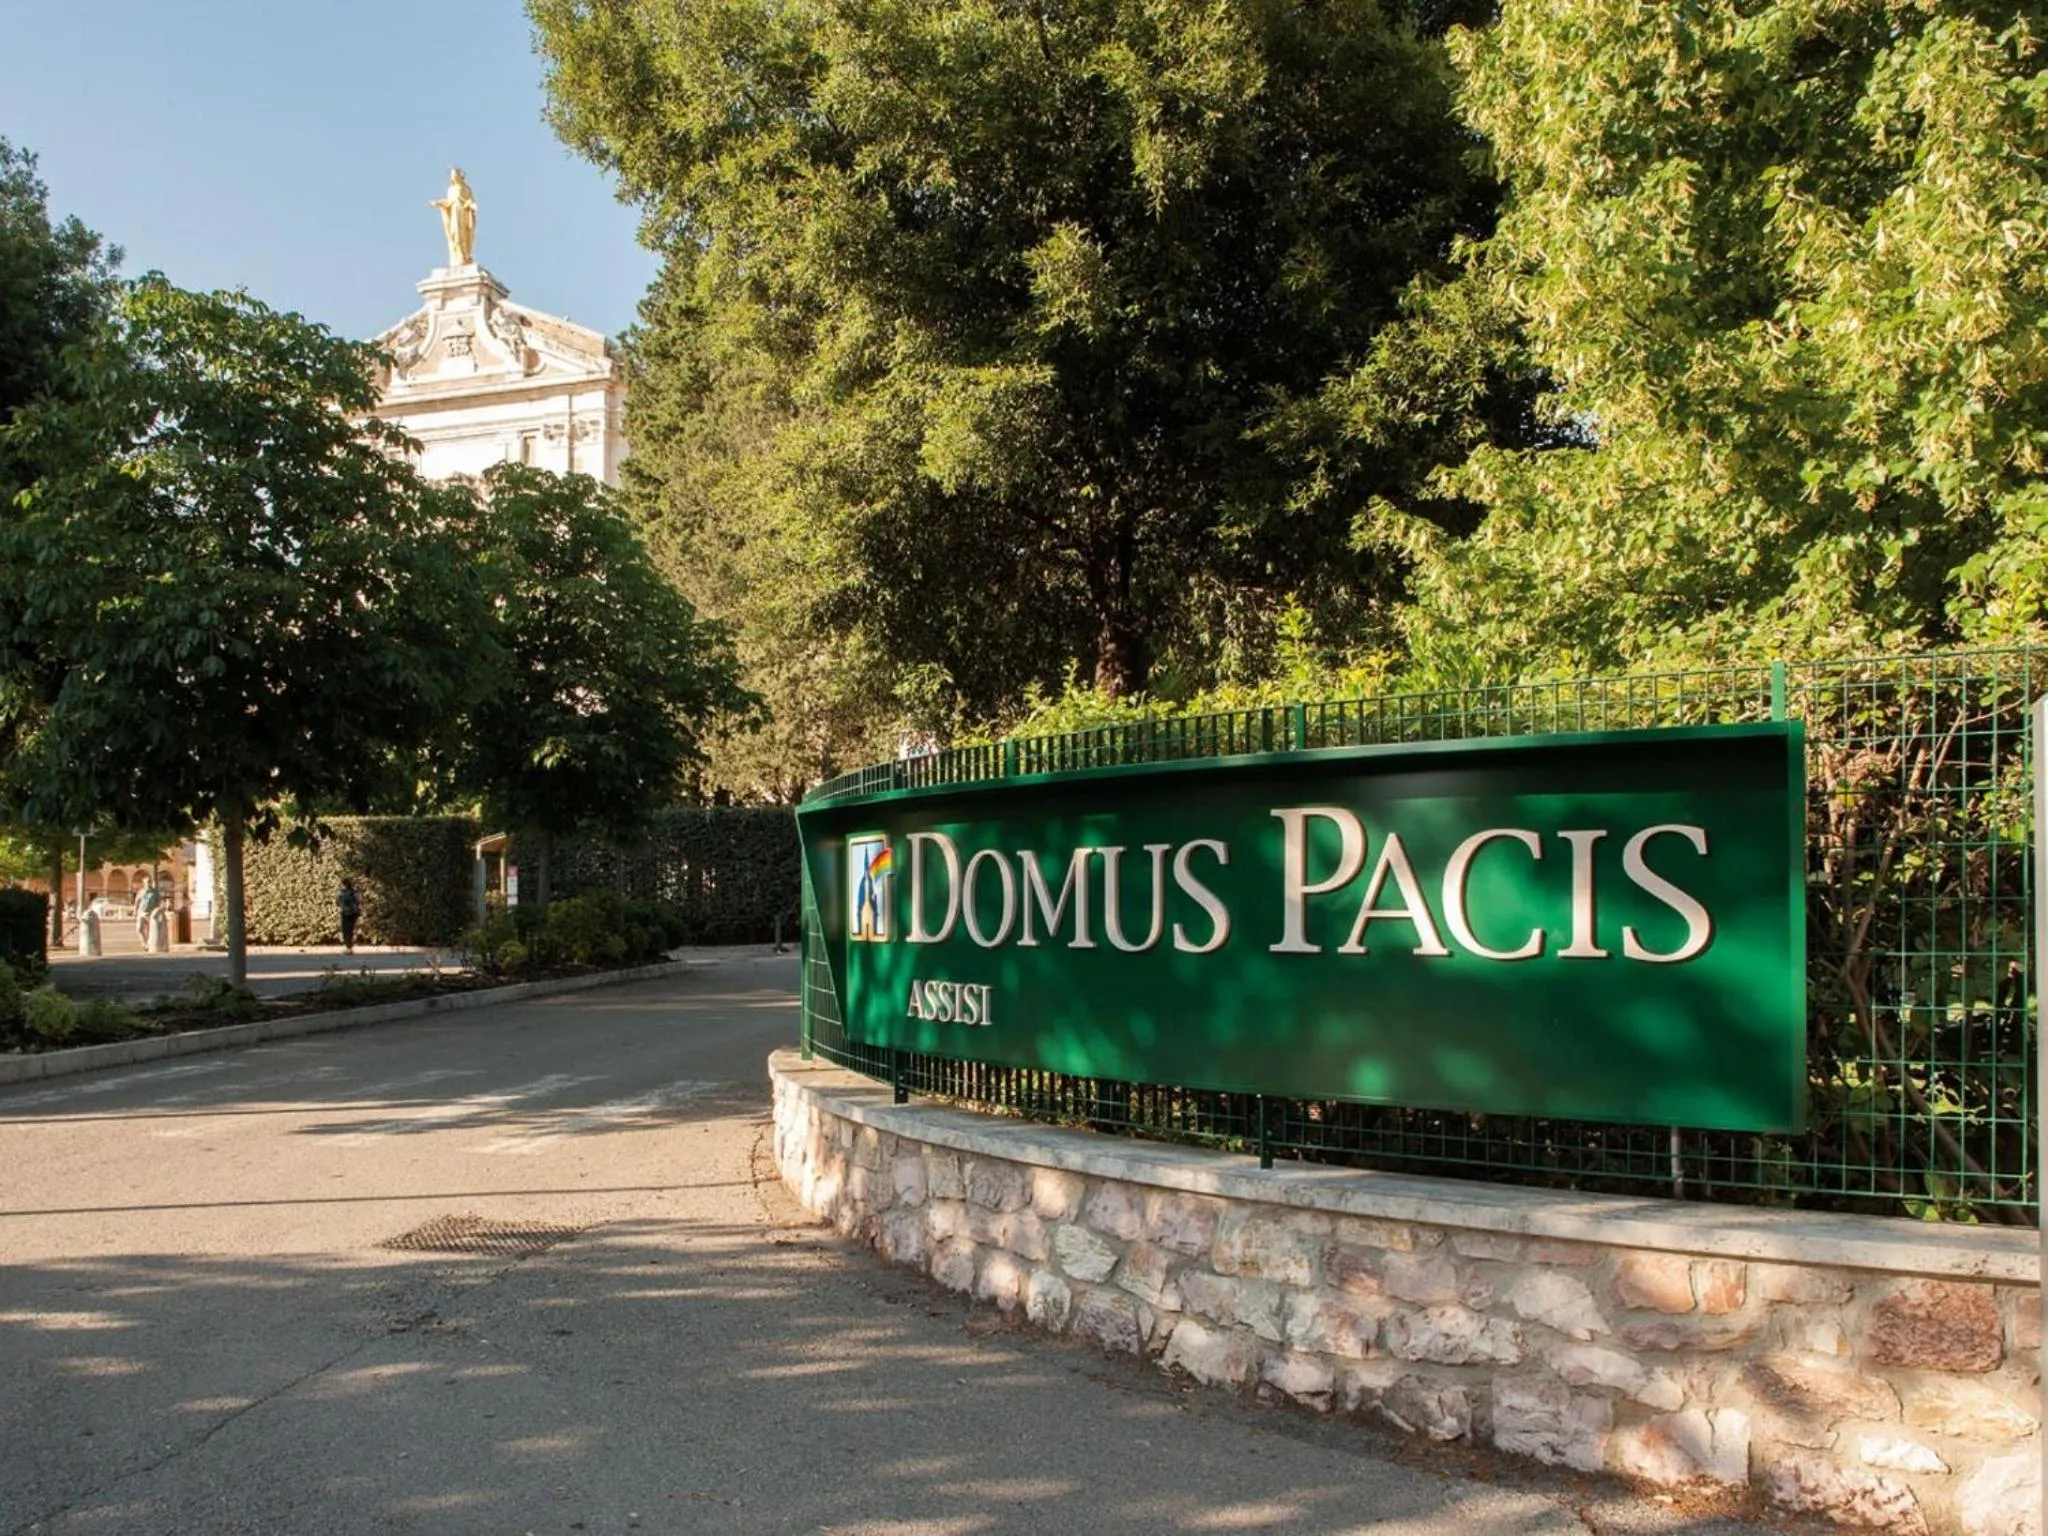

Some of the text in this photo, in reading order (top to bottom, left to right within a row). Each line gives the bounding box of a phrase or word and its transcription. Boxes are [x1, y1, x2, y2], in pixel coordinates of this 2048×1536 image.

[906, 807, 1713, 963] DOMUS PACIS
[907, 980, 993, 1026] ASSISI
